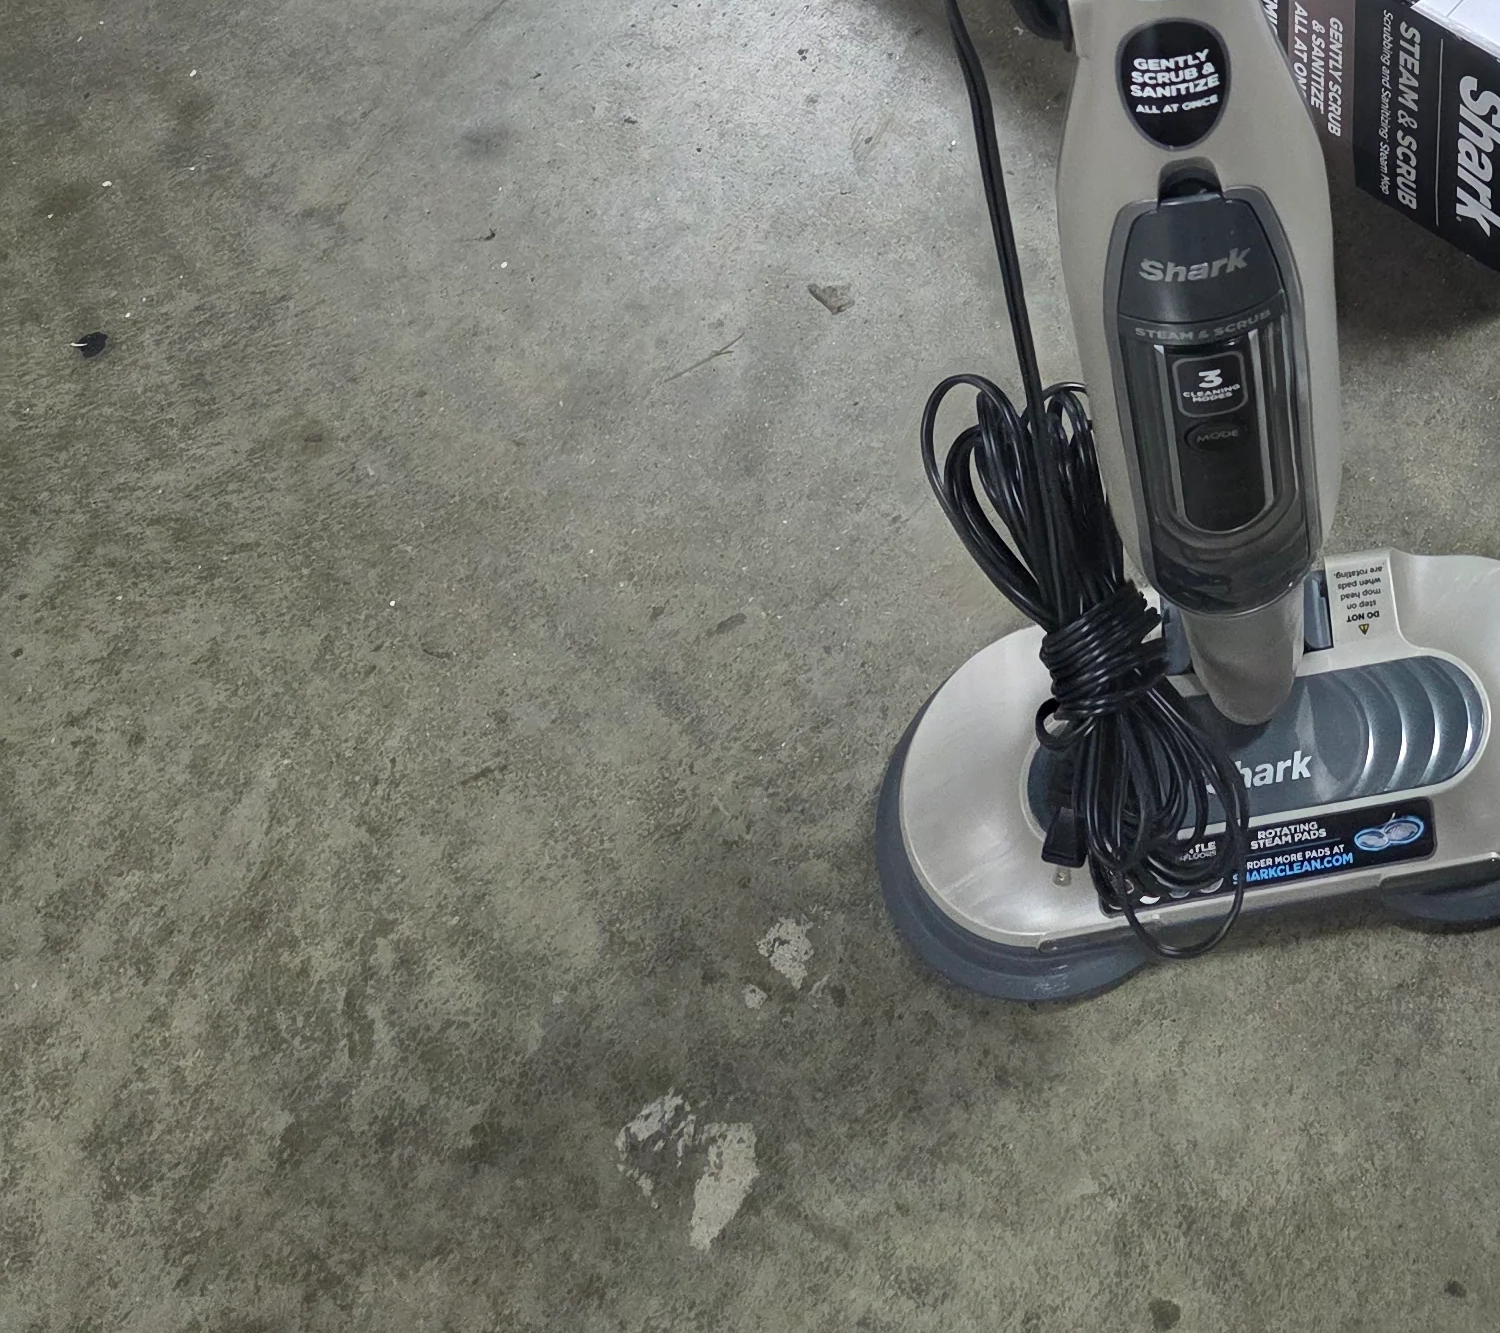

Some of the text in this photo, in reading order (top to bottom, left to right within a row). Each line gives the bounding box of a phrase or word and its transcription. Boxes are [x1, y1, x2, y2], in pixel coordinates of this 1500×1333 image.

[1380, 9, 1394, 66] Scrubbing
[1133, 48, 1209, 71] GENTLY
[1293, 1, 1309, 97] ALL AT ON
[1131, 62, 1215, 85] SCRUB &
[1310, 19, 1326, 114] & SANITIZE
[1327, 16, 1344, 137] GENTLY SCRUB
[1130, 73, 1220, 98] SANITIZE
[1381, 68, 1393, 88] and
[1136, 94, 1219, 113] ALL AT ONCE
[1396, 21, 1420, 210] STEAM & SCRUB
[1379, 142, 1390, 172] Steam
[1379, 171, 1390, 195] Mop
[1139, 247, 1251, 282] Shark
[1135, 327, 1194, 341] STEAM
[1213, 309, 1271, 336] SCRUB
[1198, 369, 1223, 388] 3
[1183, 383, 1241, 399] CLEANING
[1193, 391, 1234, 403] MODES
[1196, 429, 1240, 443] MODE
[1333, 568, 1368, 579] rotating.
[1337, 577, 1382, 591] when pads
[1340, 588, 1382, 602] mop head
[1359, 599, 1377, 608] step
[1346, 610, 1380, 623] DO NOT
[1250, 828, 1327, 850] STEAM PADS
[1257, 821, 1319, 840] ROTATING
[1245, 844, 1345, 870] RDER MORE PADS AT
